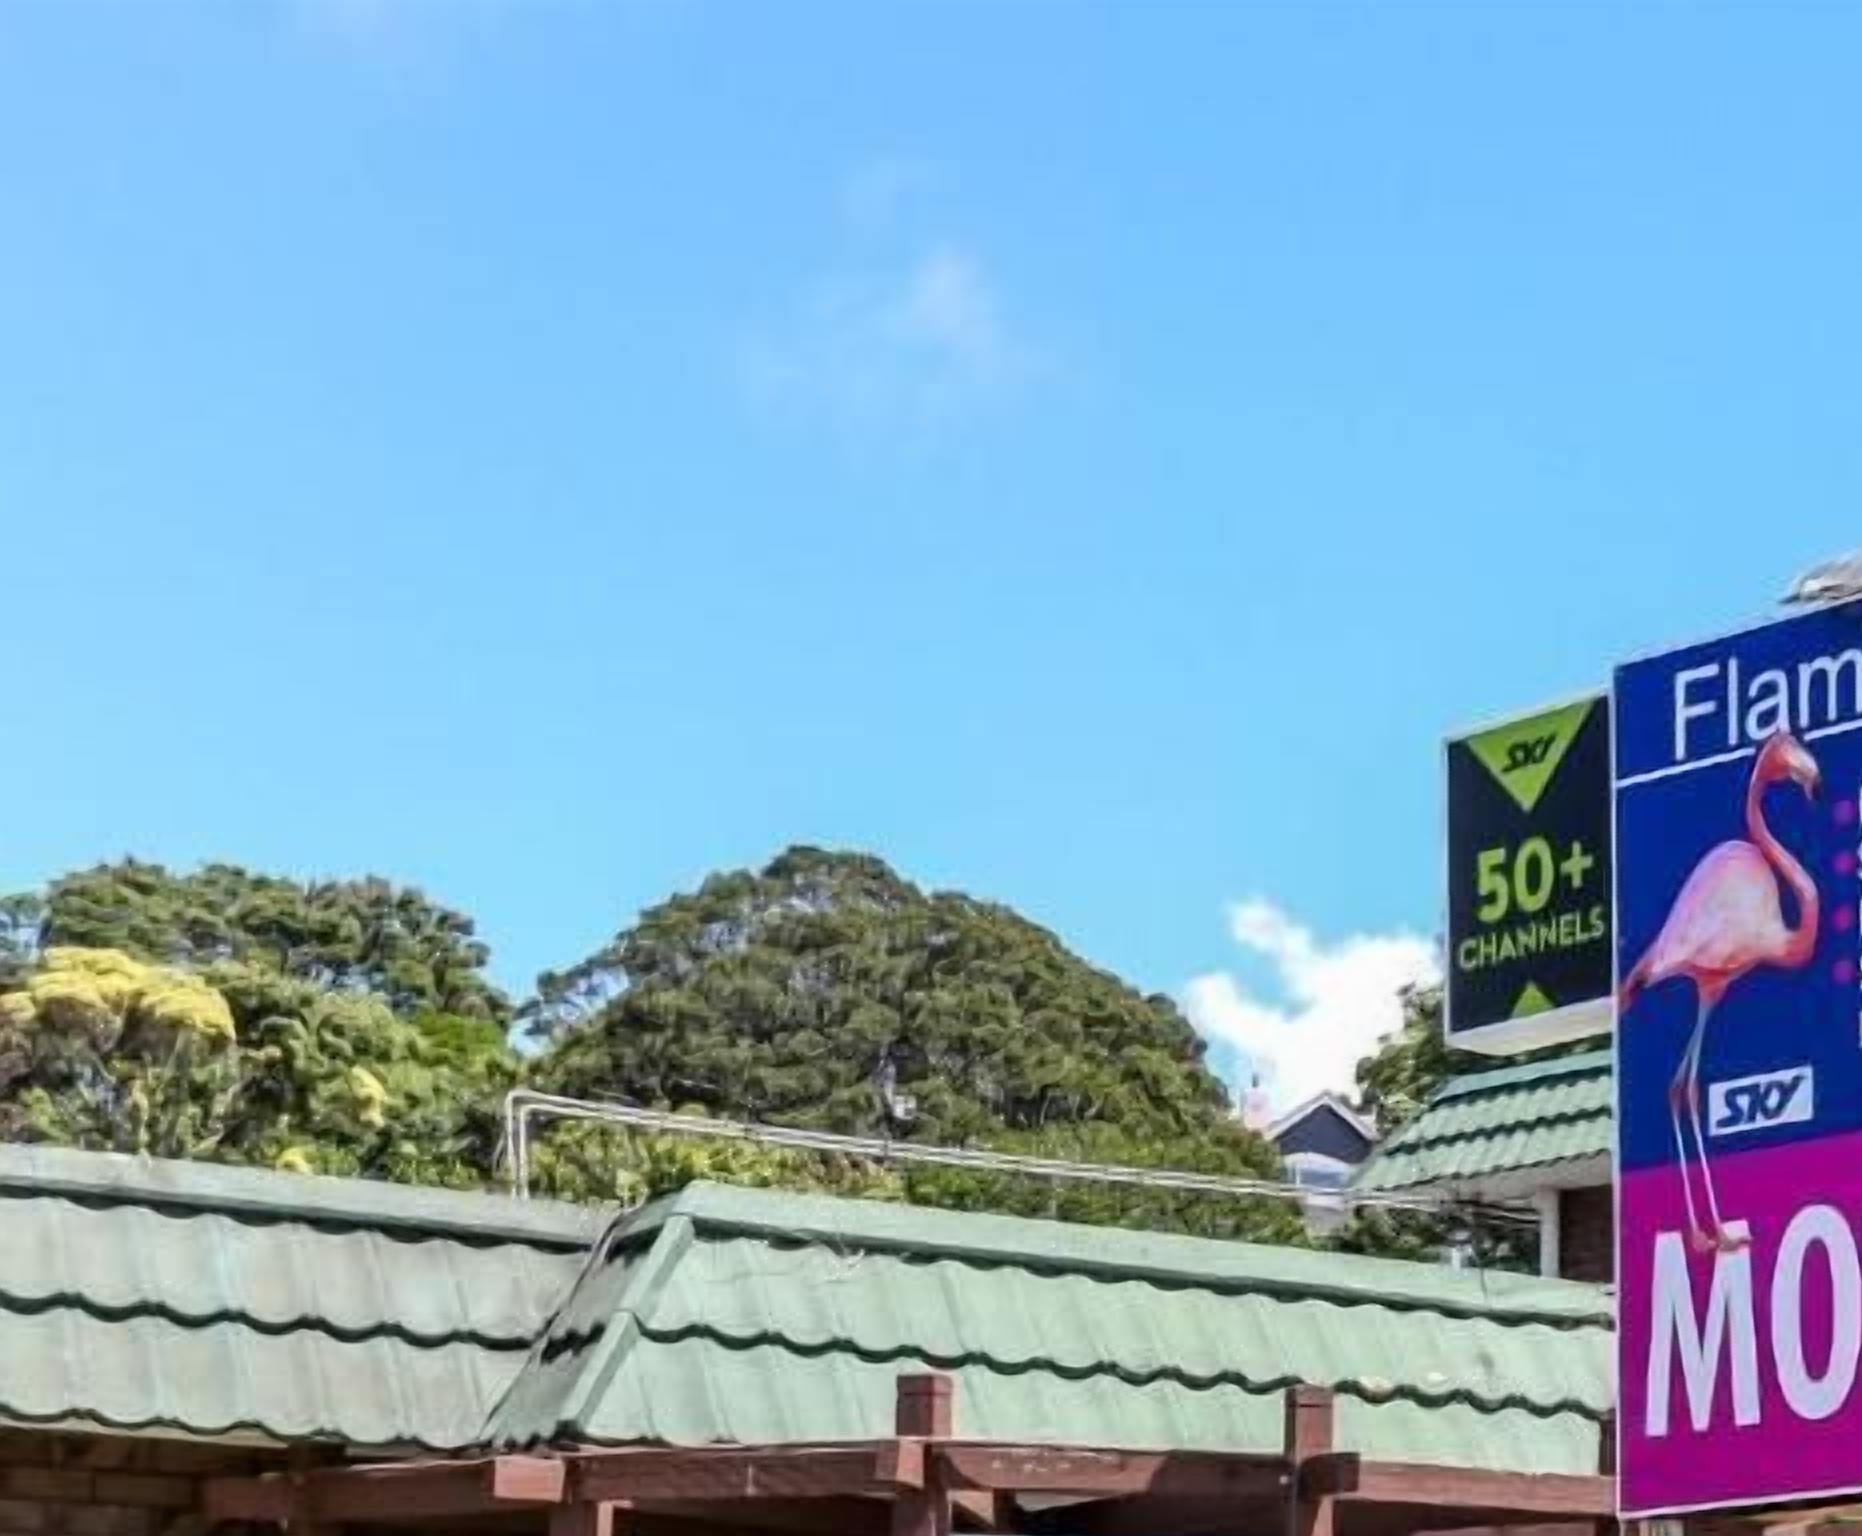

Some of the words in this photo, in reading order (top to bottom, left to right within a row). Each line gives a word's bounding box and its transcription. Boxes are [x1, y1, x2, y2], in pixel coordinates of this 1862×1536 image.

[1476, 836, 1593, 924] 50+
[1459, 906, 1604, 972] CHANNELS
[1716, 1074, 1804, 1129] SKY
